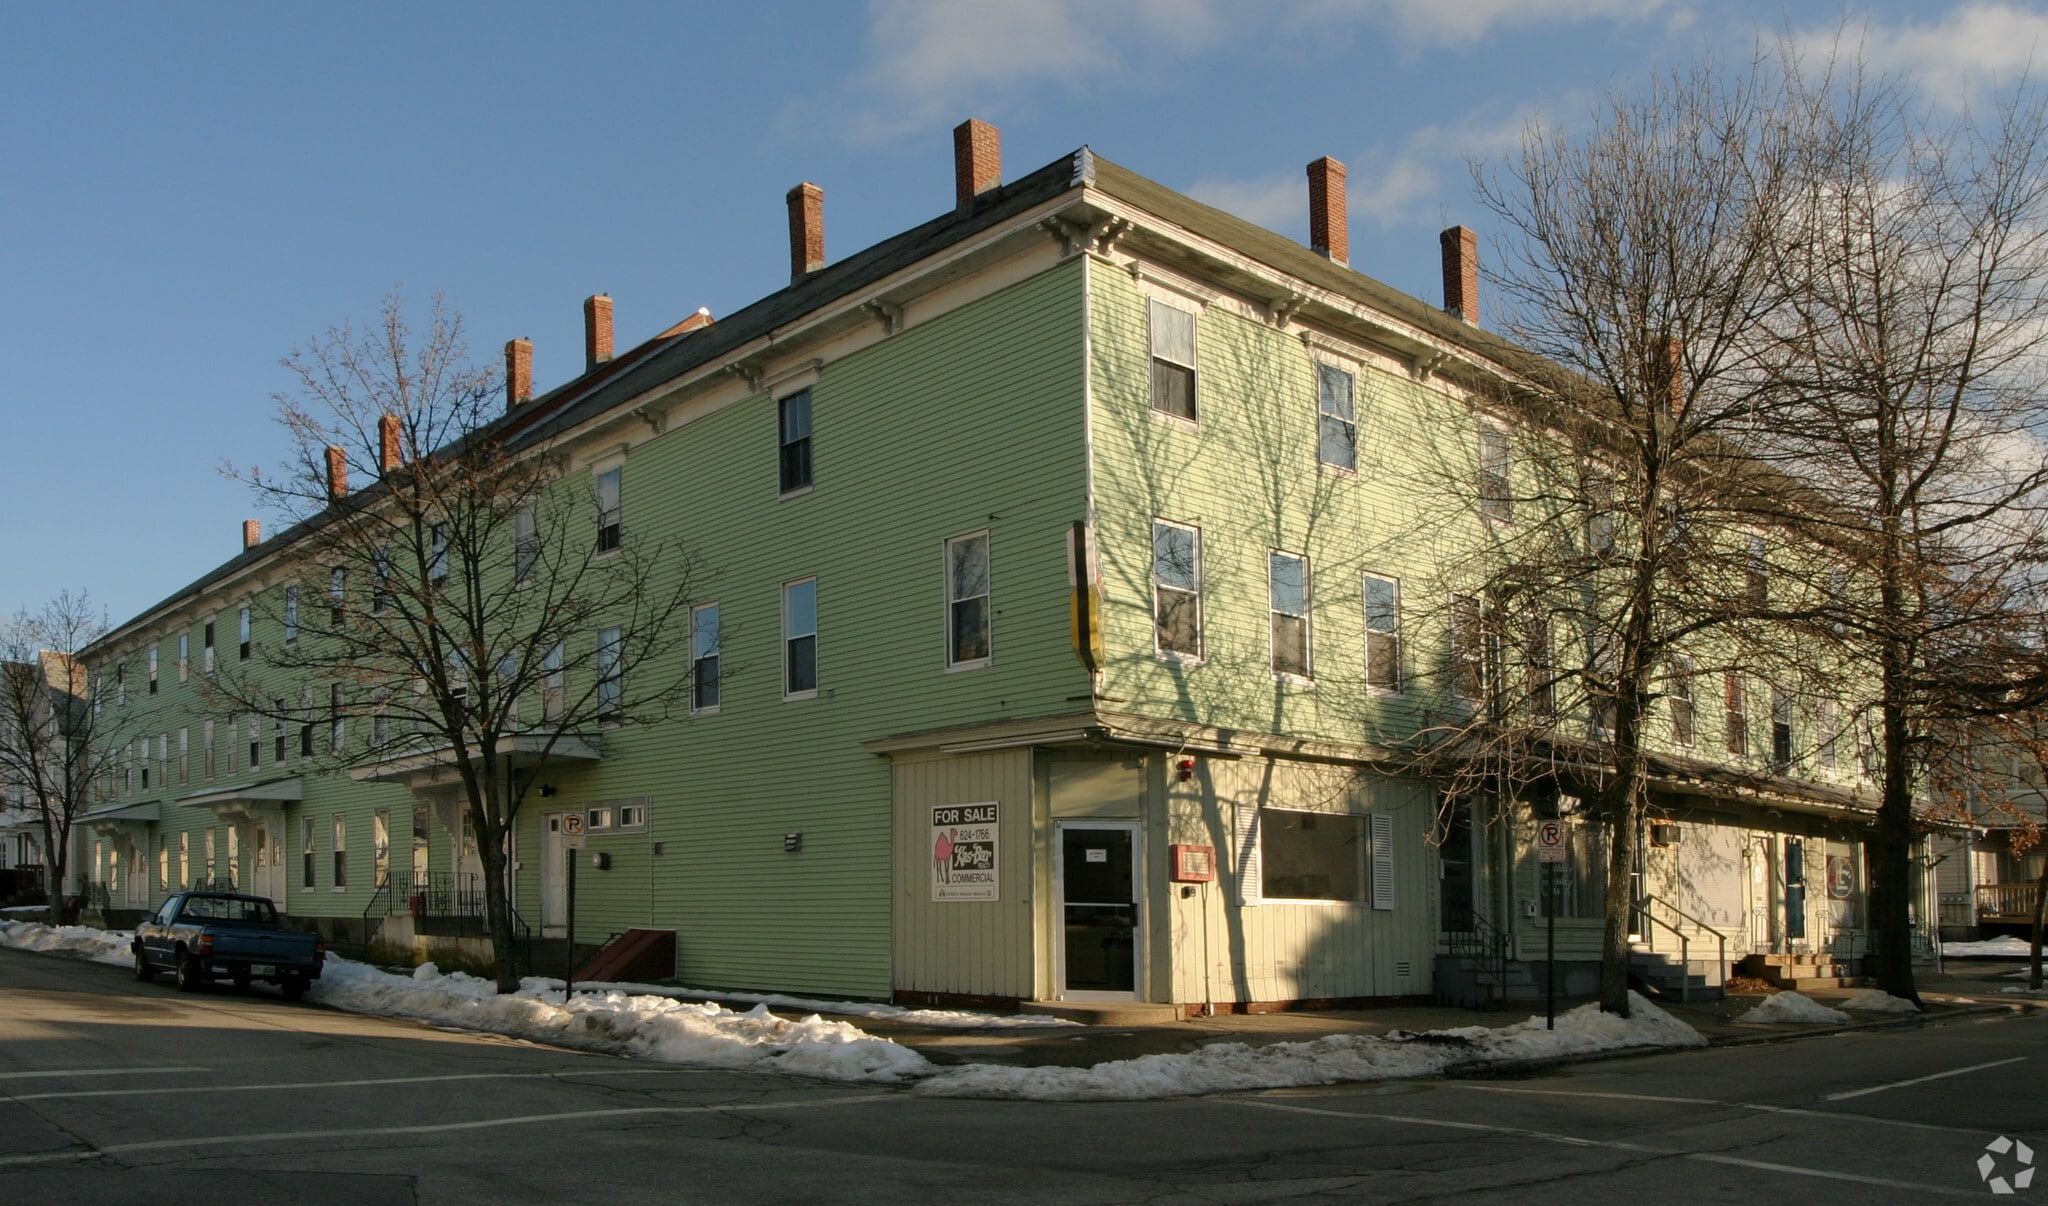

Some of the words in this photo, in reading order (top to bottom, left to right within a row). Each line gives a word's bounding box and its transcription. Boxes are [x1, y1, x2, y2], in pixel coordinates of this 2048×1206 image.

[935, 809, 959, 823] FOR
[964, 807, 995, 822] SALE
[952, 872, 994, 883] COMMERCIAL
